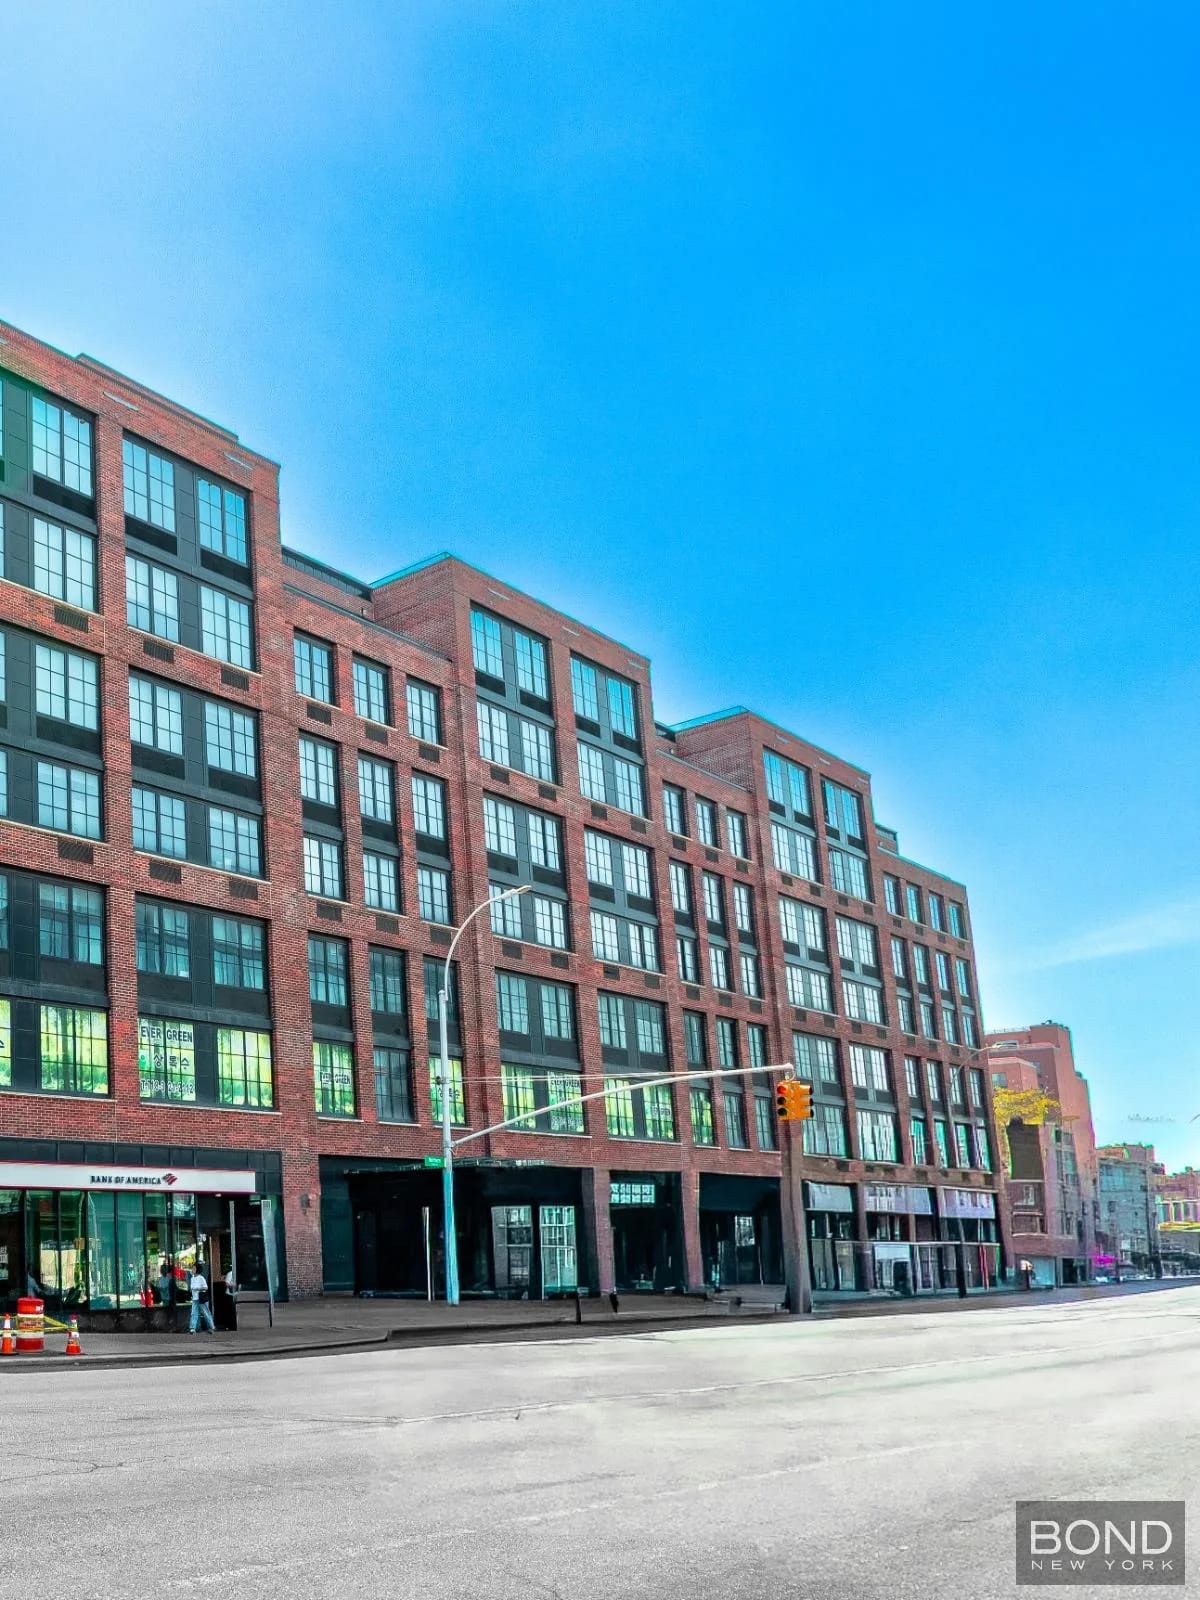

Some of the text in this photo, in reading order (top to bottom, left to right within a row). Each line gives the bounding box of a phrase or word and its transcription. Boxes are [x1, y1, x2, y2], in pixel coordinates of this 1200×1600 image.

[140, 1026, 193, 1043] EVER GREEN
[90, 1175, 161, 1185] BANK OF AMERICA
